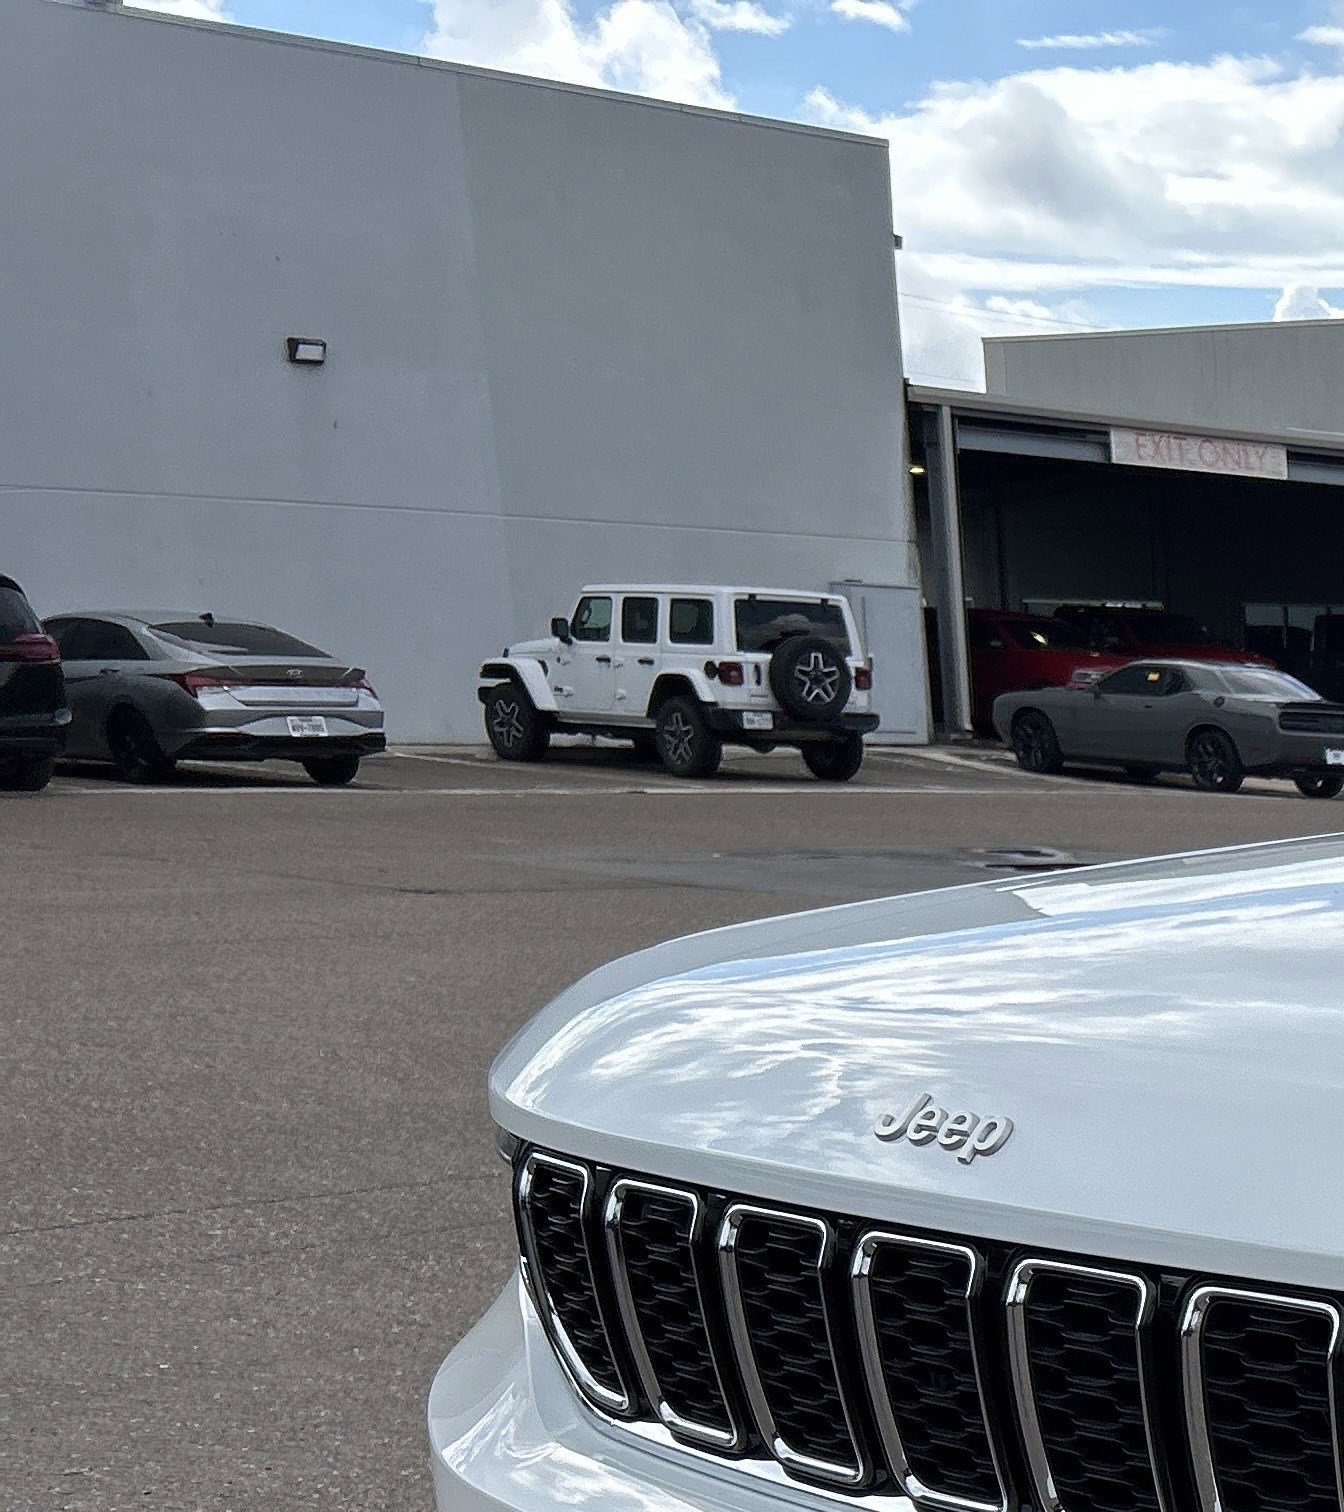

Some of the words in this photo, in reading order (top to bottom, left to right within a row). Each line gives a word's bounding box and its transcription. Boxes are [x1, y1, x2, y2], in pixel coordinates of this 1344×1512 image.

[1135, 431, 1188, 465] EXIT
[1198, 437, 1268, 472] ONLY
[873, 1092, 1014, 1166] Jeep
